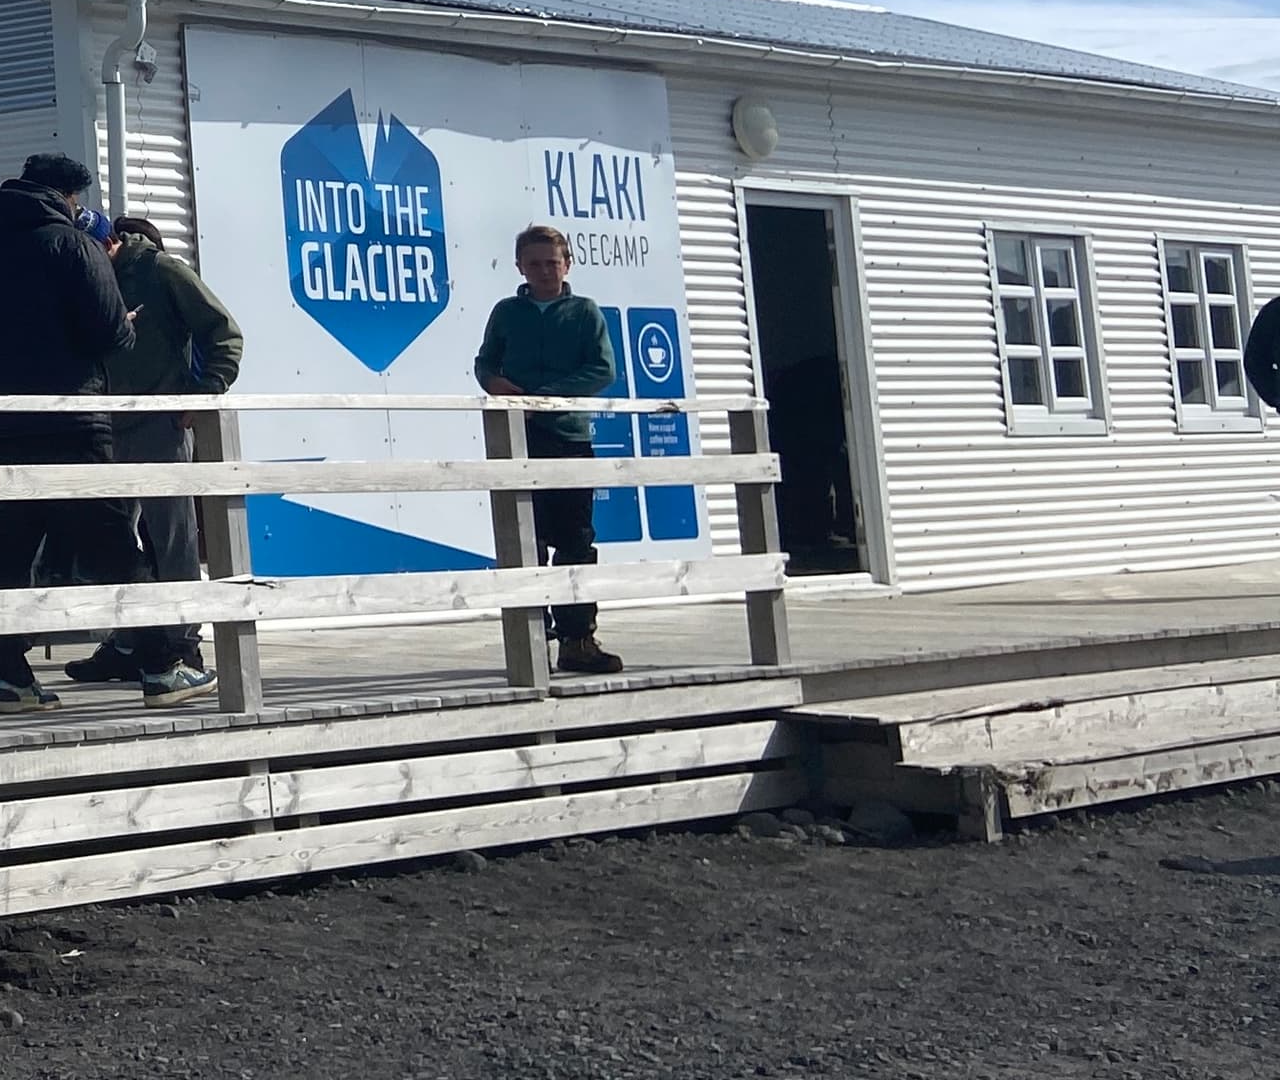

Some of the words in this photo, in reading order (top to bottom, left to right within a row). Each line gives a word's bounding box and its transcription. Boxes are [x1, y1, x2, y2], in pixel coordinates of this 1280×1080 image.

[295, 178, 366, 235] INTO
[374, 183, 432, 238] THE
[544, 149, 646, 222] KLAKI
[300, 240, 439, 303] GLACIER
[565, 231, 649, 268] ASECAMP
